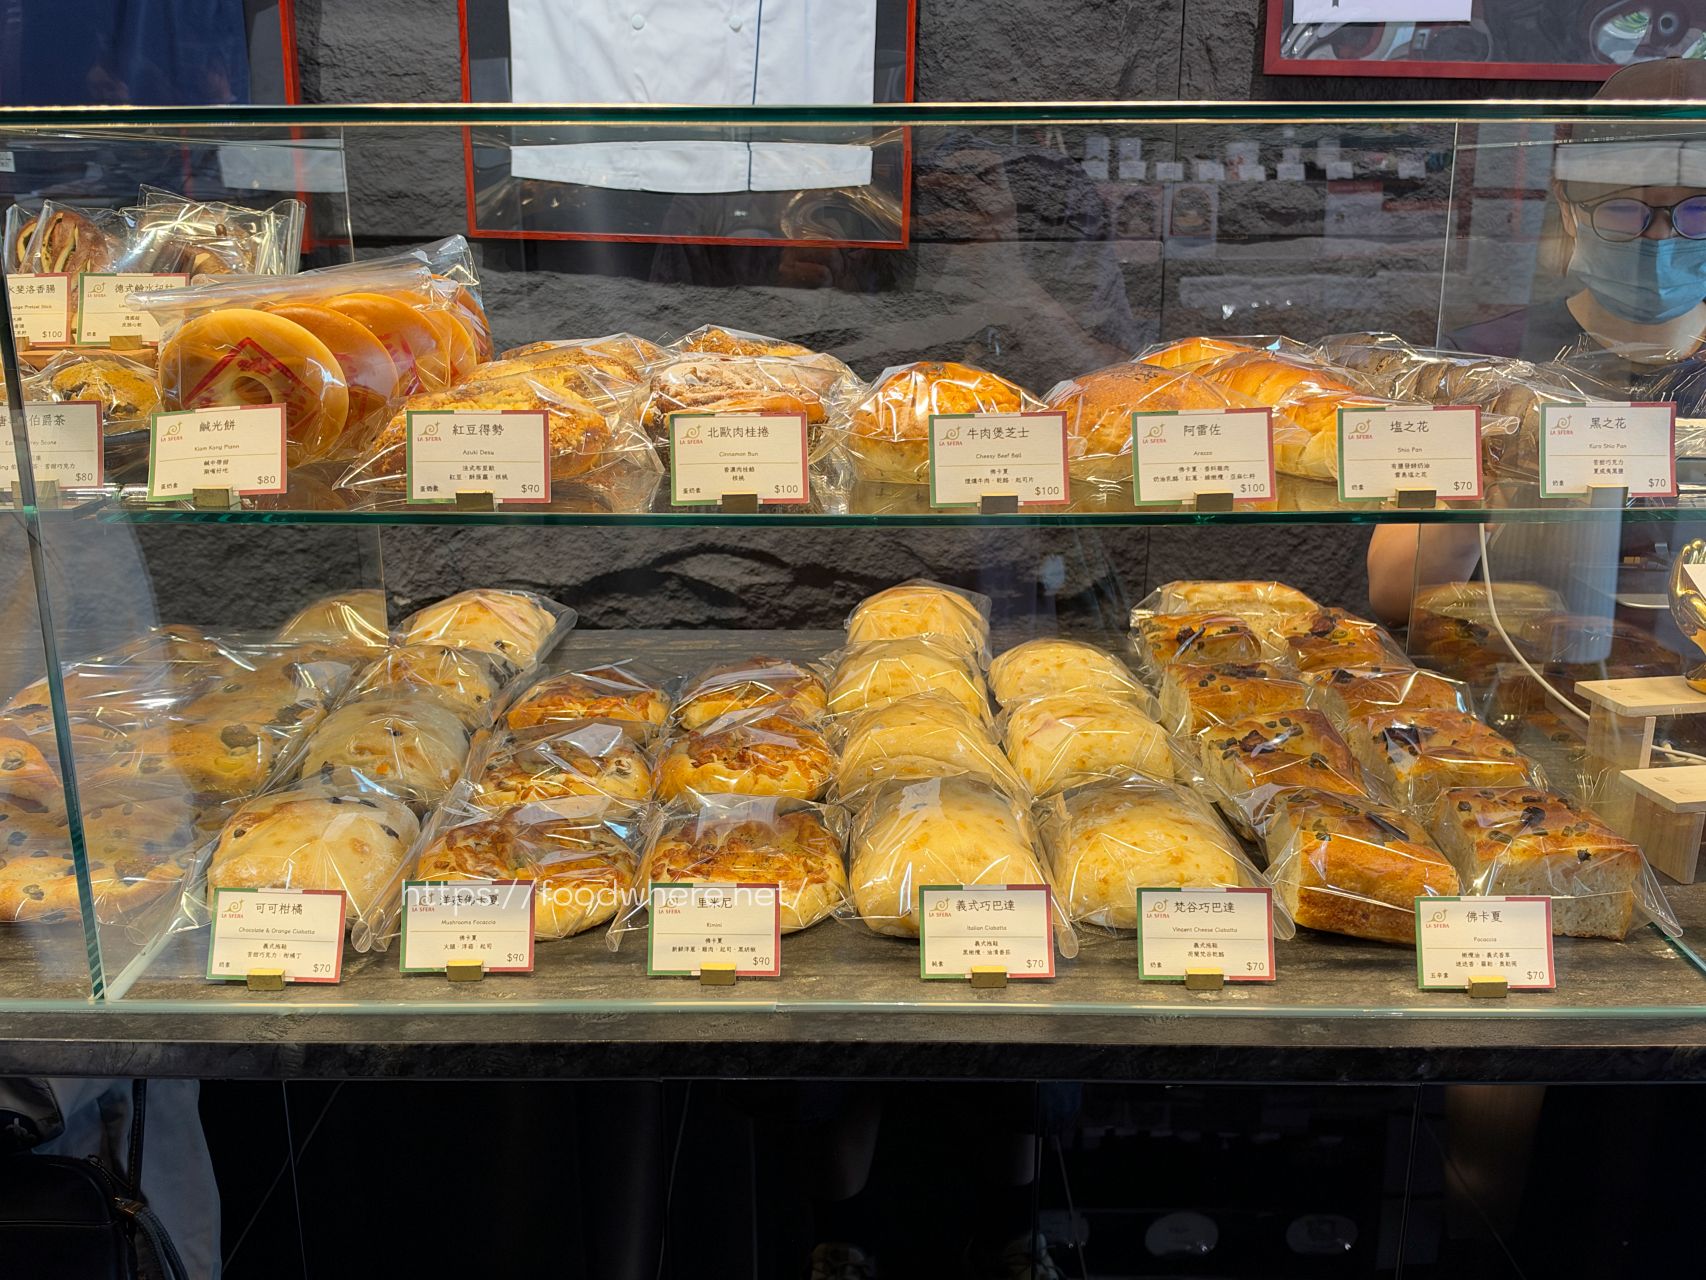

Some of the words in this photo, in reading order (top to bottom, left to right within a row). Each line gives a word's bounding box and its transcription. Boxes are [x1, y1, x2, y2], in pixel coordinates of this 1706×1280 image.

[42, 331, 62, 339] $100
[199, 419, 236, 433] 鹹光餅
[1390, 420, 1429, 433] 塩之花
[1590, 417, 1627, 429] 黑之花
[452, 424, 504, 436] 紅豆得勢
[708, 426, 770, 438] 北歐肉桂捲
[967, 426, 1030, 439] 牛肉煲芝士
[1184, 423, 1221, 437] 阿雷佐
[75, 473, 93, 481] $80
[257, 475, 276, 485] $80
[1240, 483, 1265, 493] $100
[1453, 481, 1472, 491] $70
[1648, 478, 1666, 488] $70
[521, 484, 540, 494] $90
[774, 484, 798, 494] $100
[1034, 486, 1059, 496] $100
[697, 897, 733, 909] 里米尼
[956, 899, 1015, 912] 義式巧巴達
[1174, 901, 1236, 914] 梵谷巧巴達
[256, 903, 303, 915] 可可柑橘
[1466, 910, 1503, 923] 佛卡夏
[506, 953, 524, 963] $90
[752, 956, 770, 966] $90
[313, 963, 331, 973] $70
[1026, 959, 1044, 969] $70
[1246, 961, 1264, 971] $70
[1527, 971, 1544, 980] $70
